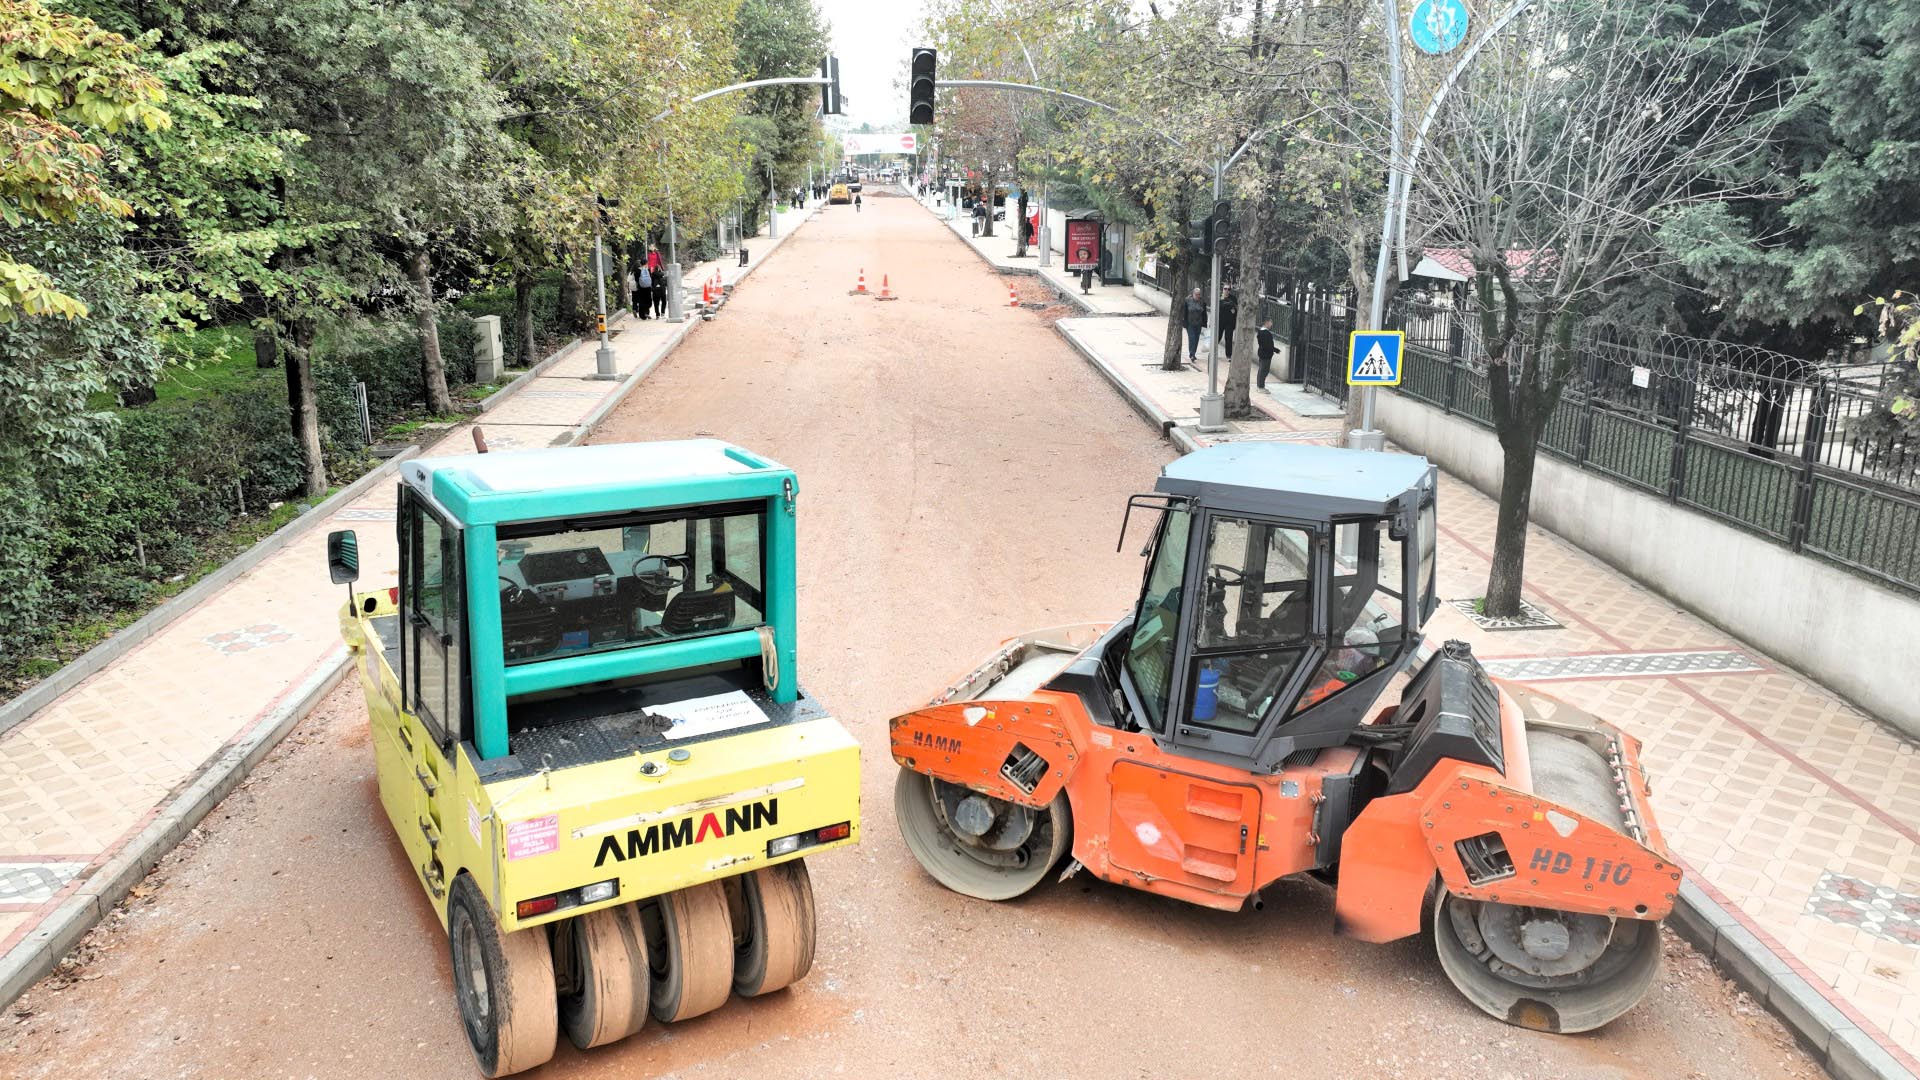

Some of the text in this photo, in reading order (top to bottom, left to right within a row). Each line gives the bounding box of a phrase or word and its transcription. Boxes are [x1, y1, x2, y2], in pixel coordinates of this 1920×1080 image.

[913, 731, 962, 755] HAMM
[594, 798, 778, 868] AMMANN
[1529, 847, 1633, 886] HD 110
